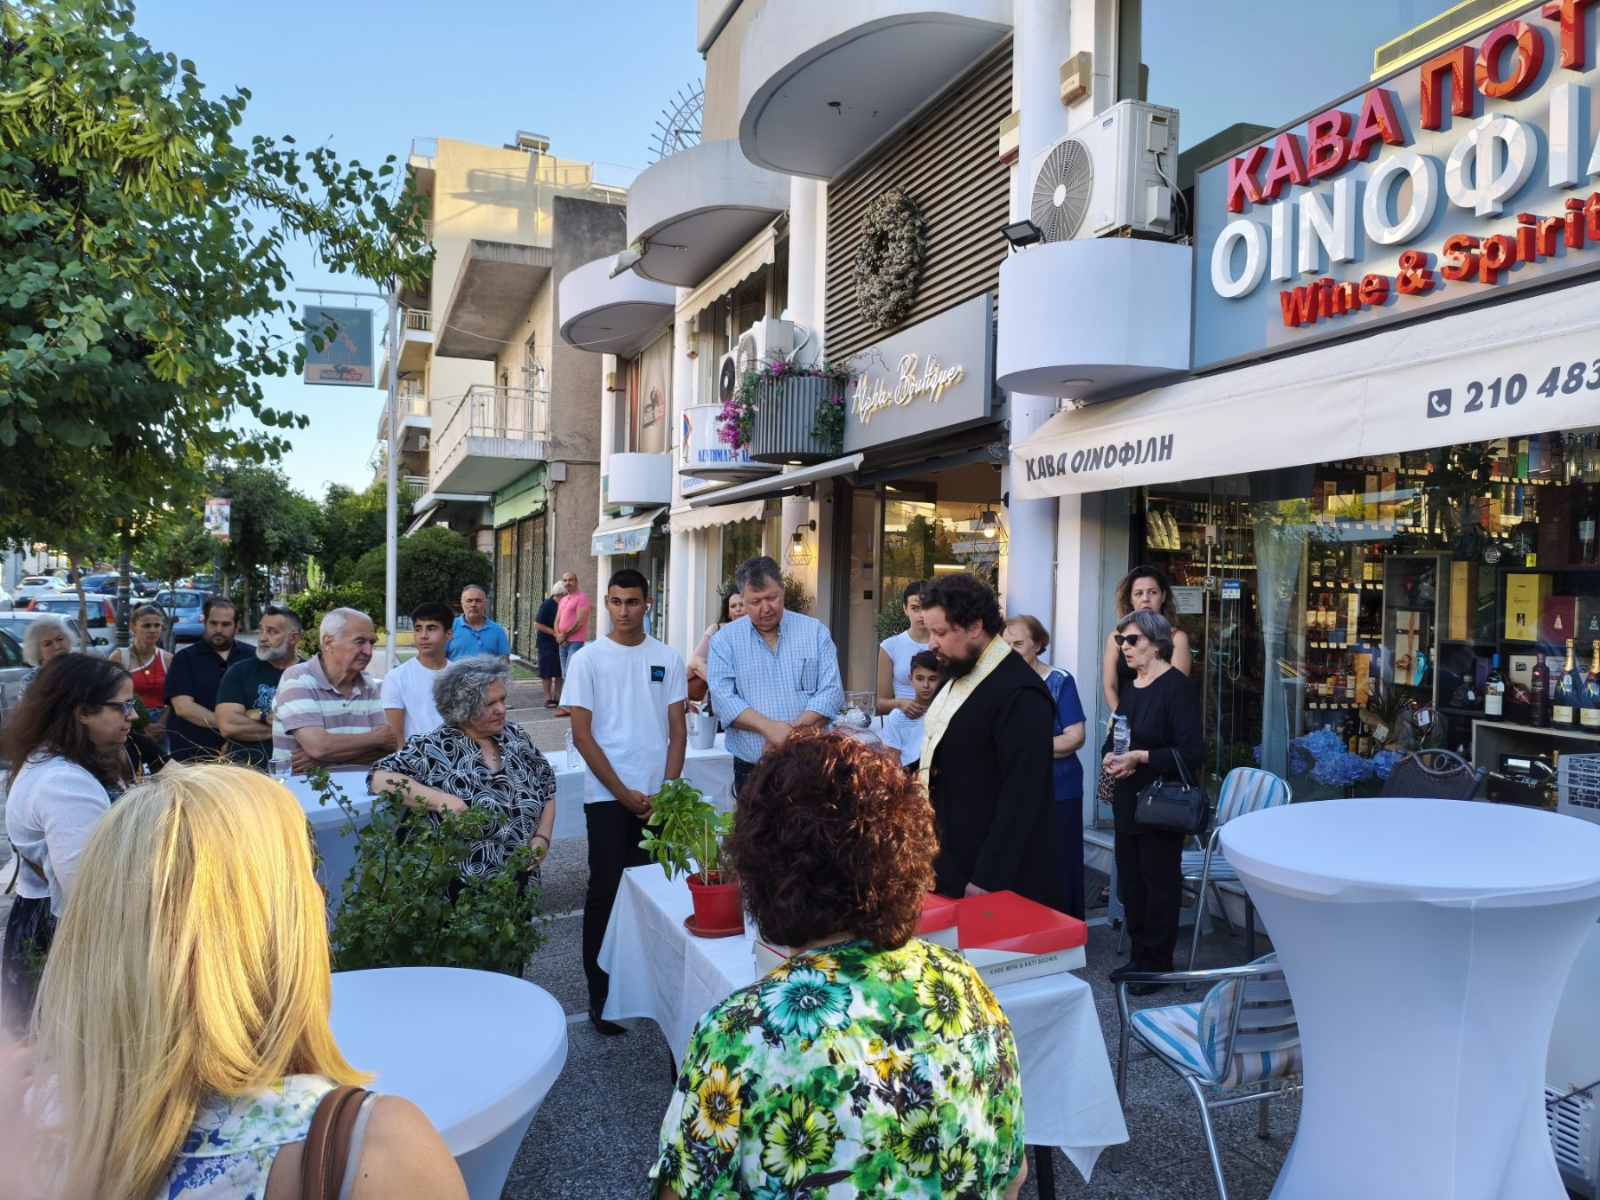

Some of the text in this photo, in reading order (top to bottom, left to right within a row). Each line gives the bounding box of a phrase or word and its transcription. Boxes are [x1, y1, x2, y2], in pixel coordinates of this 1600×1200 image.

[1227, 87, 1404, 213] ΚΑΒΑ
[1211, 83, 1600, 298] ΟΙΝΟΦΙ
[1280, 277, 1390, 327] Wine
[1396, 249, 1435, 296] &
[1464, 358, 1600, 413] 210 483
[1026, 433, 1174, 482] ΚΑΒΑ ΟΙΝΟΦΙΛΗ
